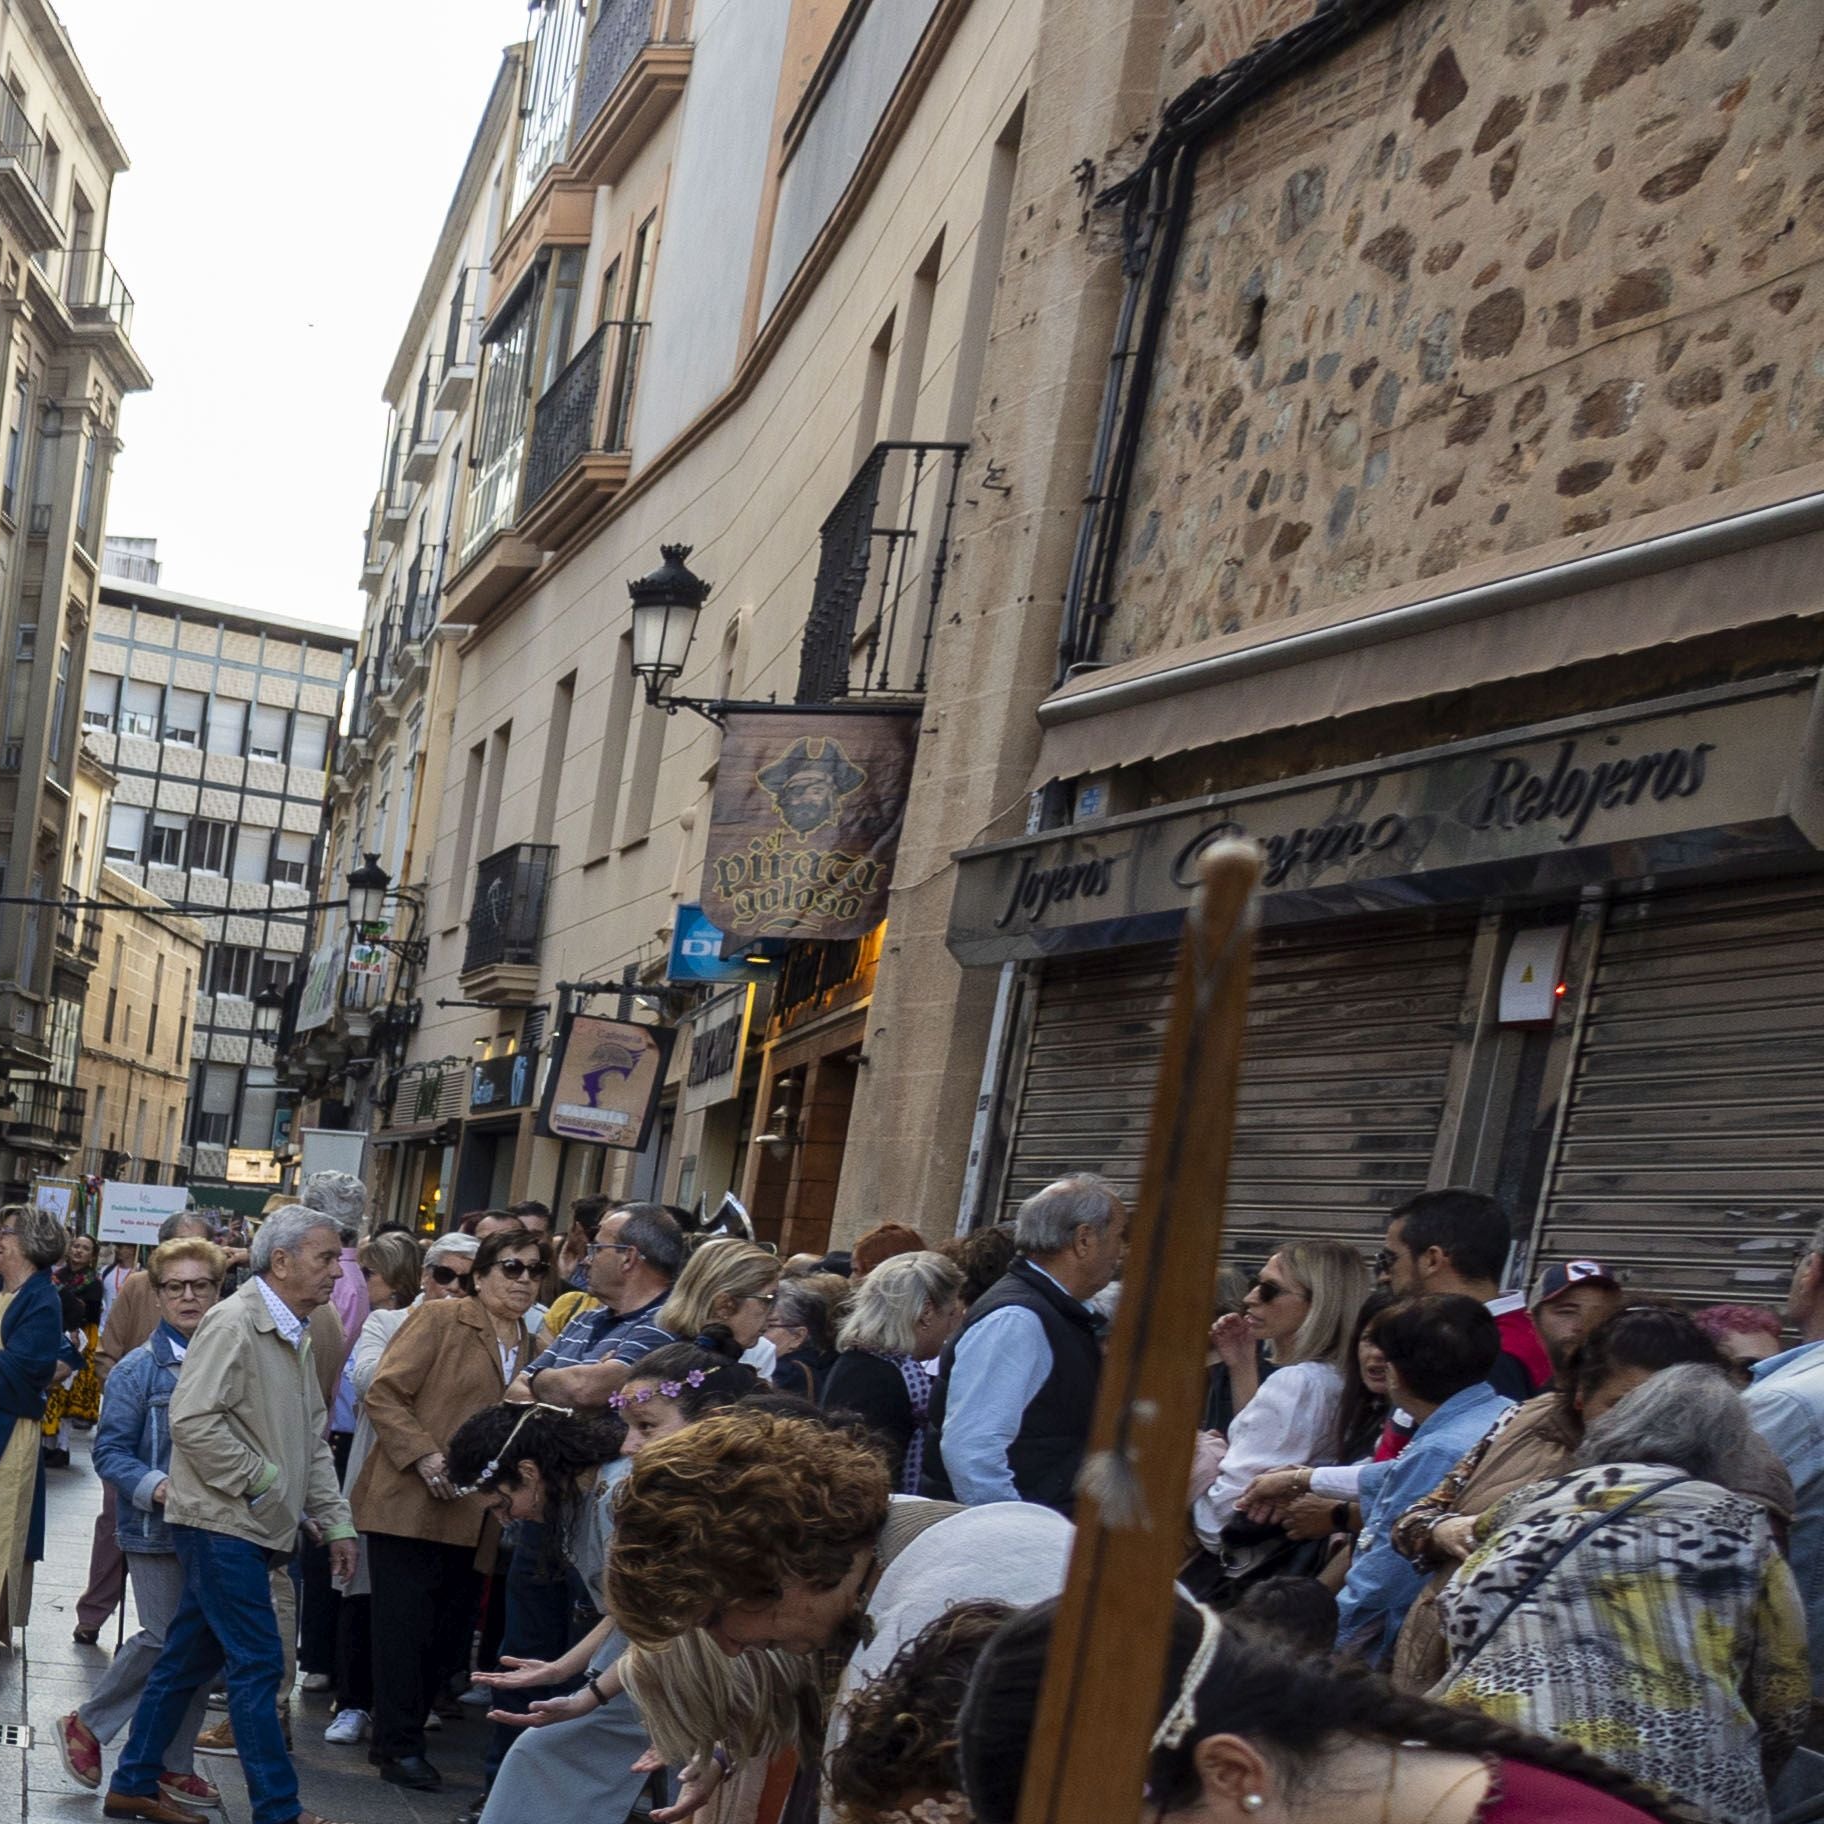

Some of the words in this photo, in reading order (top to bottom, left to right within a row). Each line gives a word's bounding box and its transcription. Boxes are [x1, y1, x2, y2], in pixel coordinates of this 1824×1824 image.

[767, 830, 784, 849] el
[993, 854, 1115, 929] Joyeros
[1470, 739, 1716, 843] Relojeros
[713, 839, 887, 900] pirata
[731, 874, 863, 930] goloso
